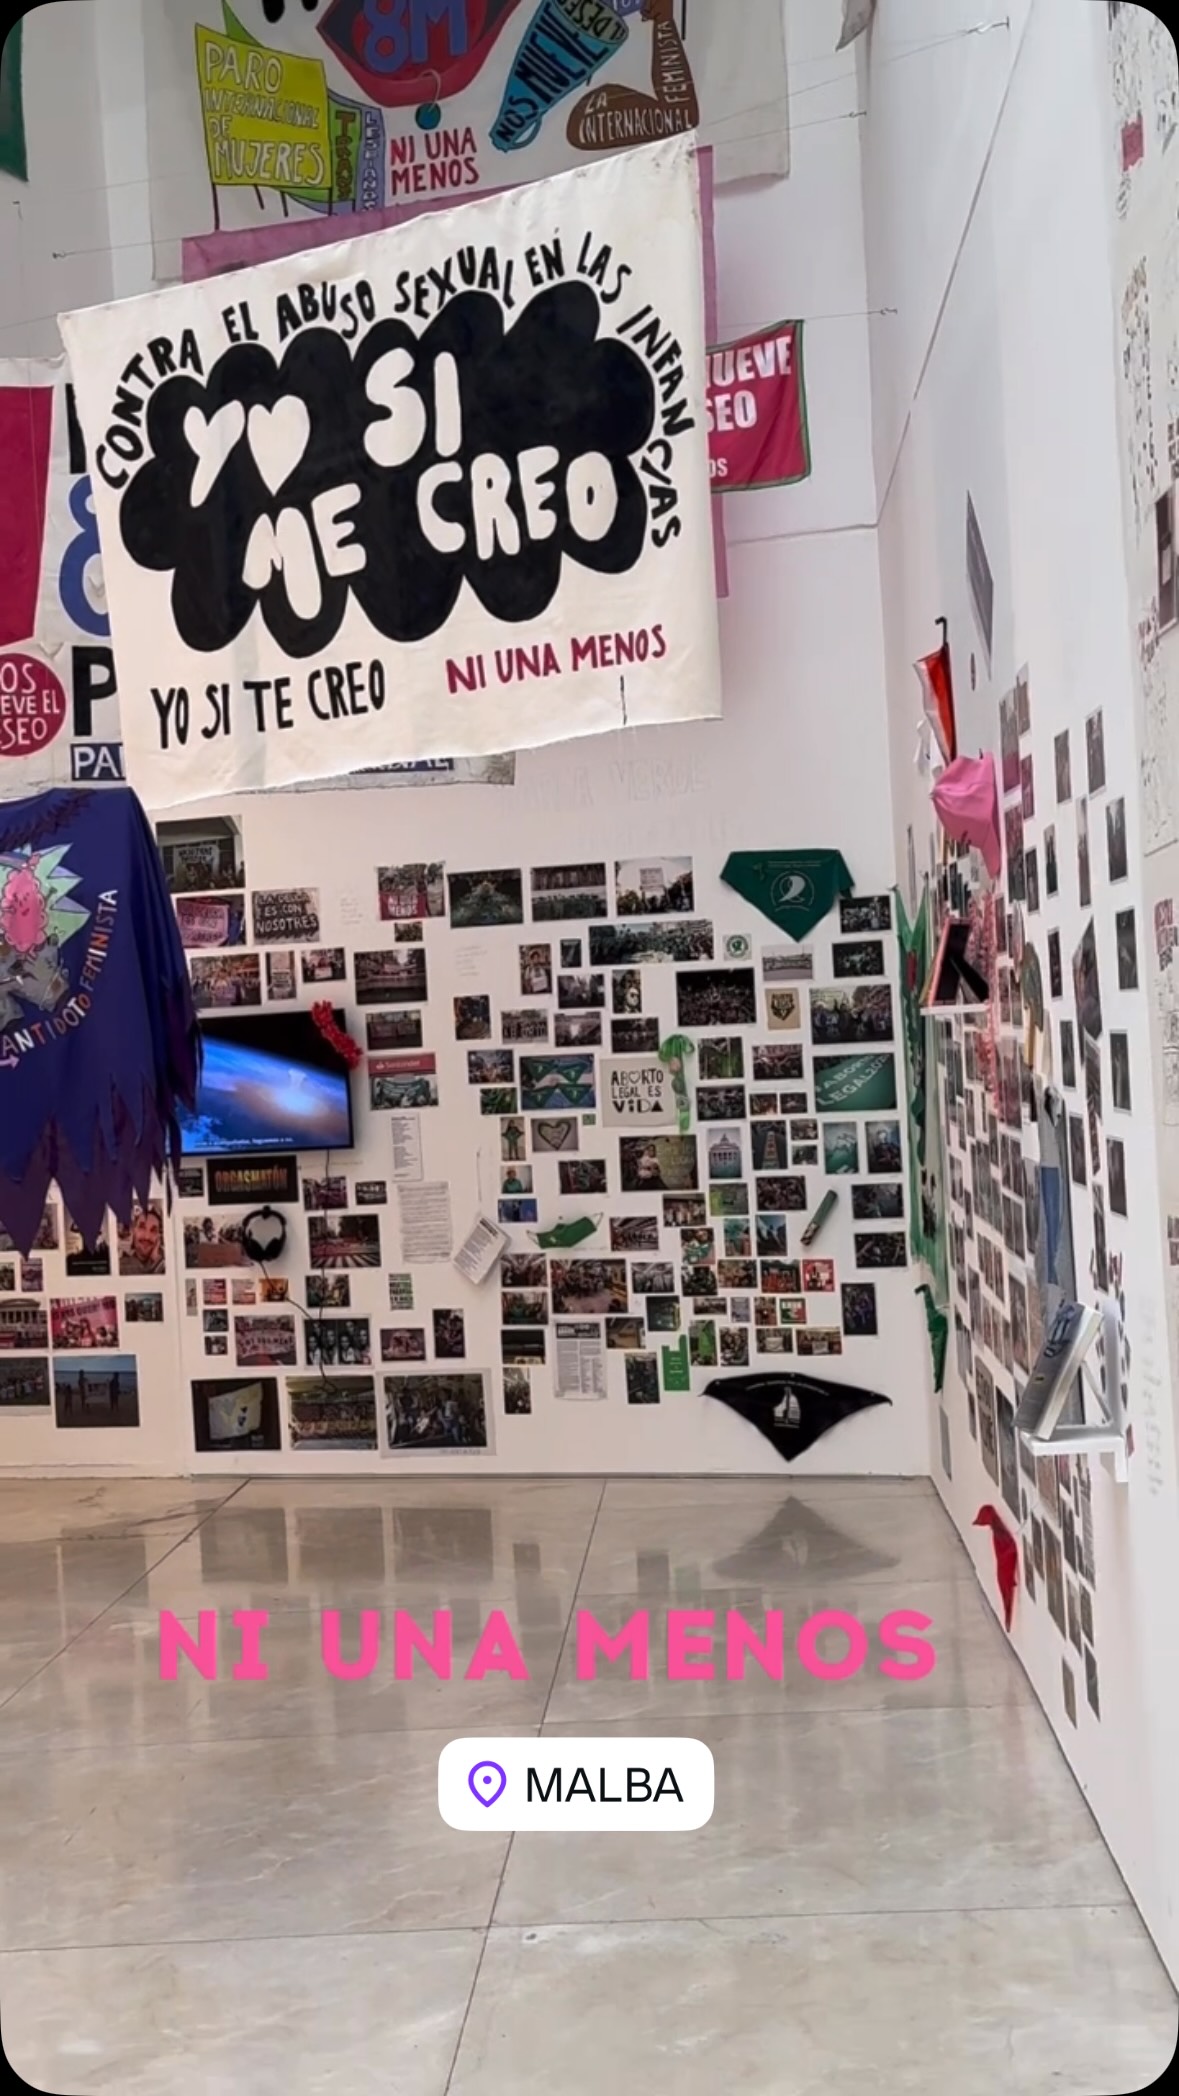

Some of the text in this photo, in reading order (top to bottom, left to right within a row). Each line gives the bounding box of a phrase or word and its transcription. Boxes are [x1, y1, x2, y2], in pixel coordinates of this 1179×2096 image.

[363, 0, 467, 73] 8M
[514, 1, 609, 104] MUEVE
[204, 41, 283, 94] PARO
[657, 20, 692, 104] FEMINISTA
[204, 87, 320, 129] INTERNACIONAL
[495, 96, 538, 142] NOS
[579, 108, 693, 143] INTERNACIONAL
[584, 92, 608, 114] LA
[209, 115, 233, 138] DE
[390, 127, 477, 166] NI UNA
[213, 138, 325, 186] MUJERES
[391, 157, 479, 196] MENOS
[96, 327, 204, 489] CONTRA
[222, 302, 259, 342] EL
[277, 279, 376, 337] ABUSO
[396, 246, 514, 318] SEXUAL
[525, 236, 565, 287] EN
[577, 232, 632, 303] LAS
[616, 305, 696, 549] INFANCIAS
[364, 347, 462, 467] SI
[242, 446, 619, 620] ME CREO
[445, 624, 667, 694] NI UNA MENOS
[42, 690, 60, 714] EL
[151, 659, 386, 749] YO SI TE CREO
[0, 717, 48, 749] SEO
[256, 914, 317, 934] NOSOTRES
[264, 903, 302, 917] ES CON
[2, 889, 118, 1057] ANTIDOTO FEMINISTA
[611, 1085, 662, 1099] LEGAL ES
